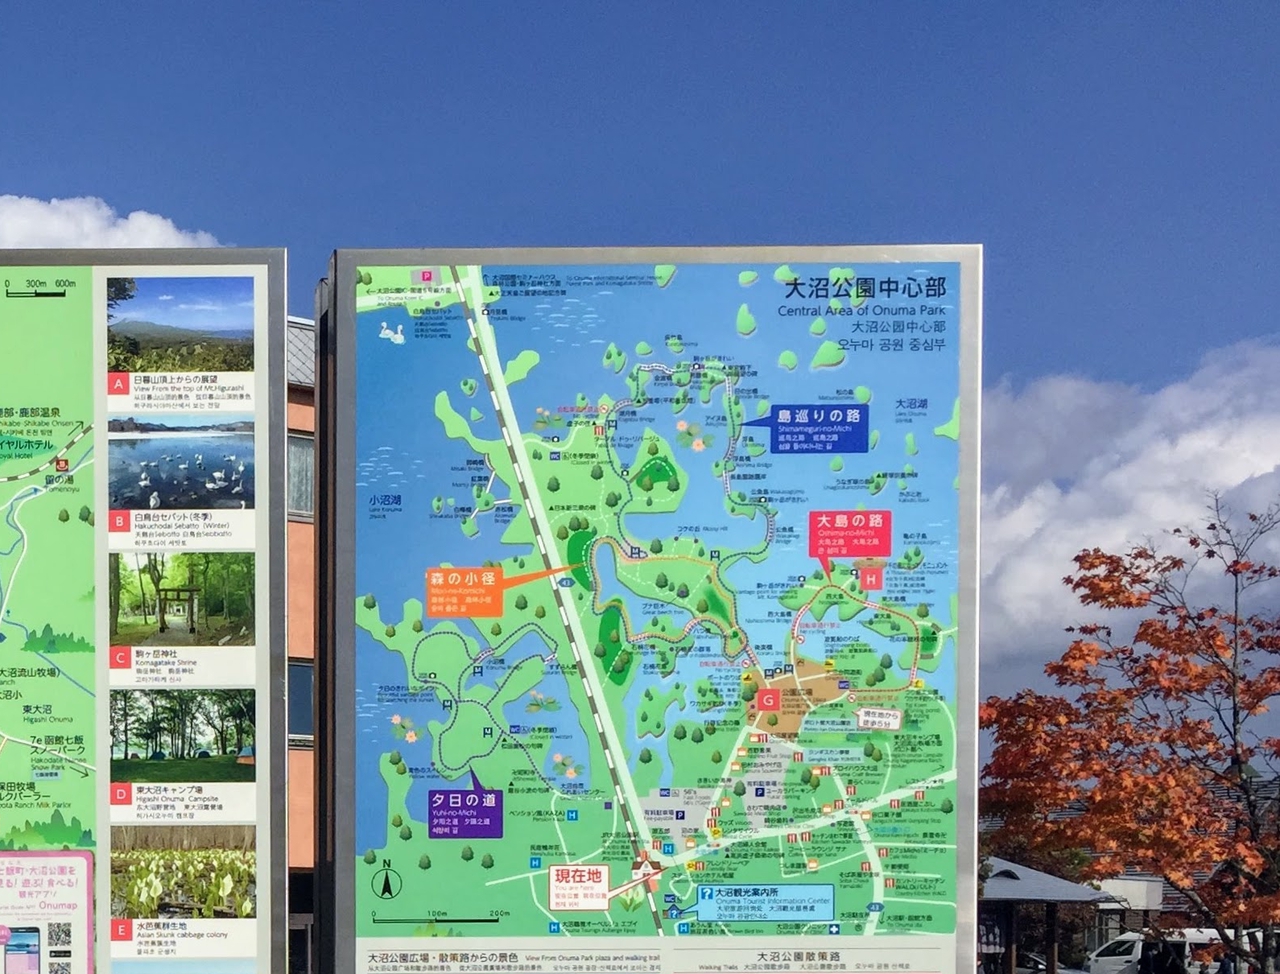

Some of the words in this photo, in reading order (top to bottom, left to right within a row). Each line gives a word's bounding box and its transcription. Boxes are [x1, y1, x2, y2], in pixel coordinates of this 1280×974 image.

[5, 280, 10, 288] 0
[26, 280, 47, 288] 300m
[55, 280, 76, 288] 600m
[785, 277, 947, 299] 大沼公園中心部
[778, 306, 822, 316] Central
[825, 306, 853, 316] Area
[857, 305, 869, 316] of
[873, 305, 916, 316] Onuma
[920, 305, 946, 316] Park
[838, 339, 874, 350] 오누마
[879, 339, 904, 351] 공원
[909, 338, 946, 351] 중심부
[114, 379, 123, 389] A
[116, 517, 123, 527] B
[866, 574, 876, 585] H
[116, 653, 125, 663] C
[763, 694, 773, 706] G
[23, 705, 52, 715] 東大沼
[116, 789, 126, 799] D
[383, 860, 391, 868] N
[555, 869, 602, 883] 現在地
[39, 901, 77, 912] Onumap
[118, 925, 126, 936] E
